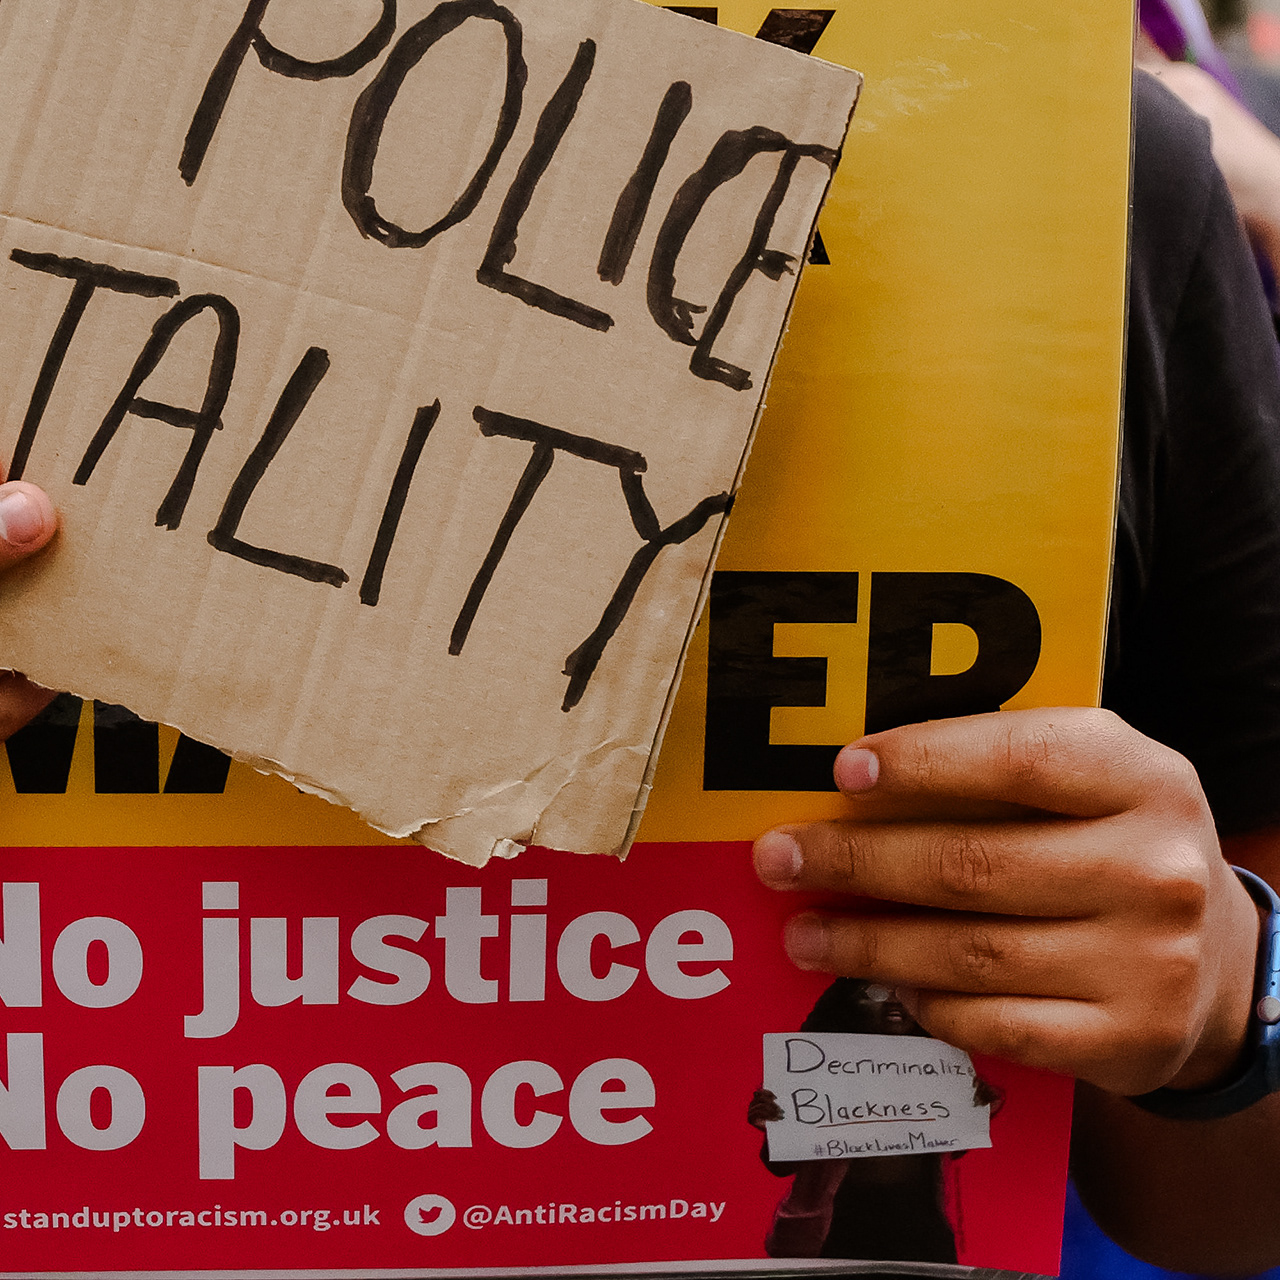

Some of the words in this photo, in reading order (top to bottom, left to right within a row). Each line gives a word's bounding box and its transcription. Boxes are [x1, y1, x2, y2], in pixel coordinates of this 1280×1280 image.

[183, 878, 735, 1038] justice
[197, 1057, 657, 1180] peace
[791, 1088, 950, 1124] Blackness
[3, 1203, 382, 1233] standuptoracism.org.uk
[462, 1197, 727, 1230] @AntiRacismDay
